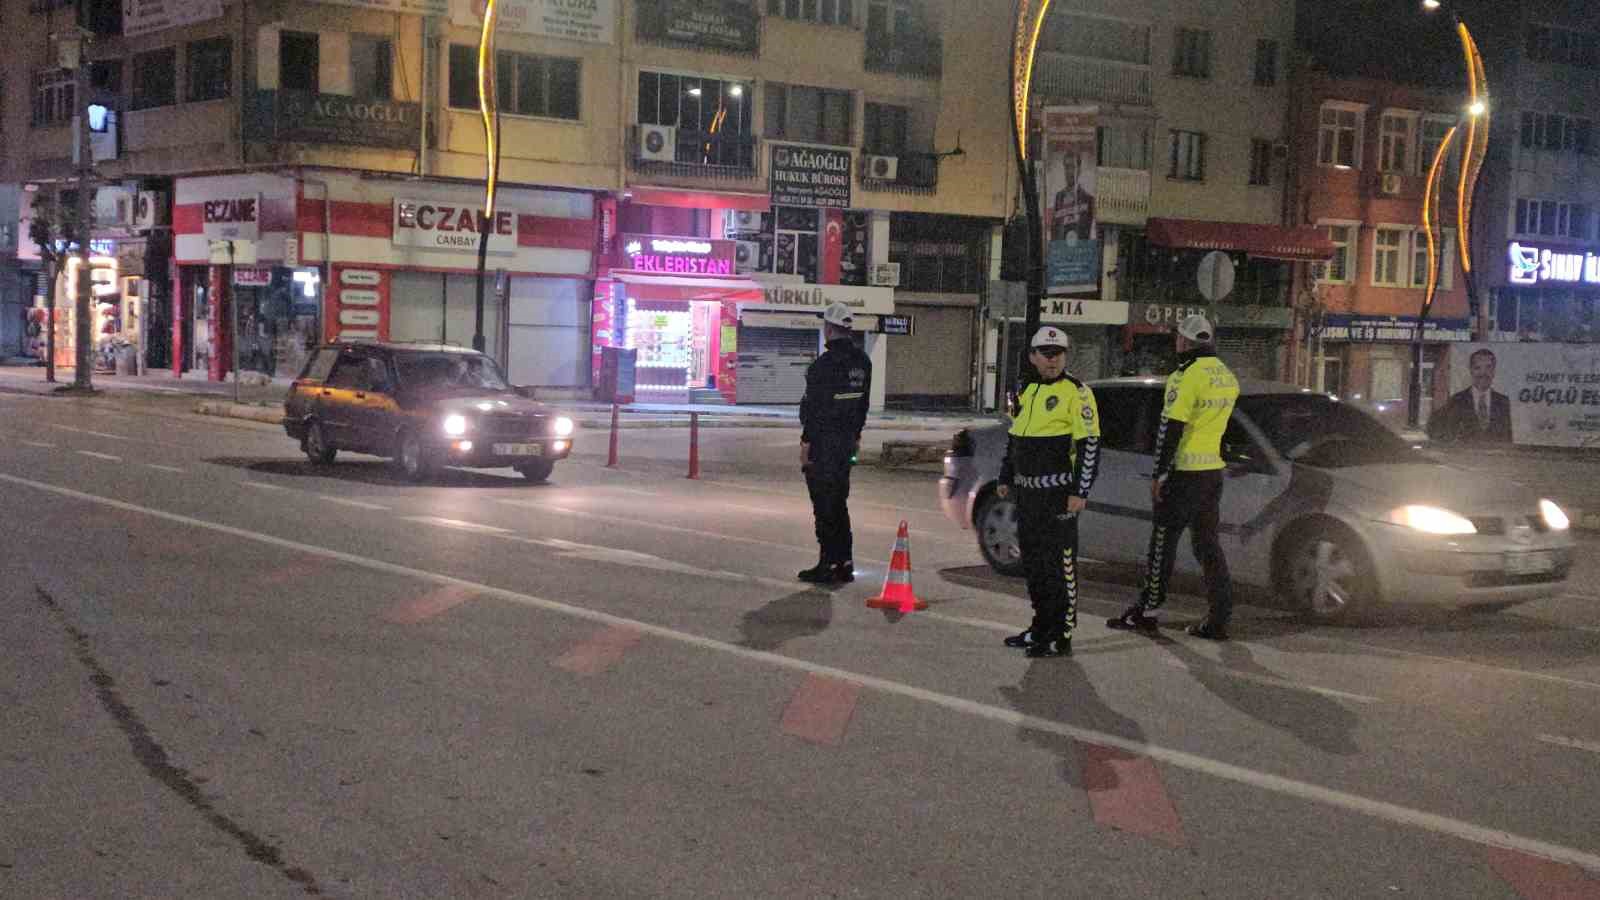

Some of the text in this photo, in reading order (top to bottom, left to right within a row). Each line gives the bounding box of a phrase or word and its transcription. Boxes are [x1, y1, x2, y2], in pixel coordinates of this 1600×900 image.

[790, 150, 849, 171] AĞAOĞLU
[811, 172, 848, 186] BÜROSU
[436, 235, 477, 246] CANBAY
[764, 285, 823, 305] KÜRKLÜ
[1518, 385, 1578, 407] GÜÇLÜ
